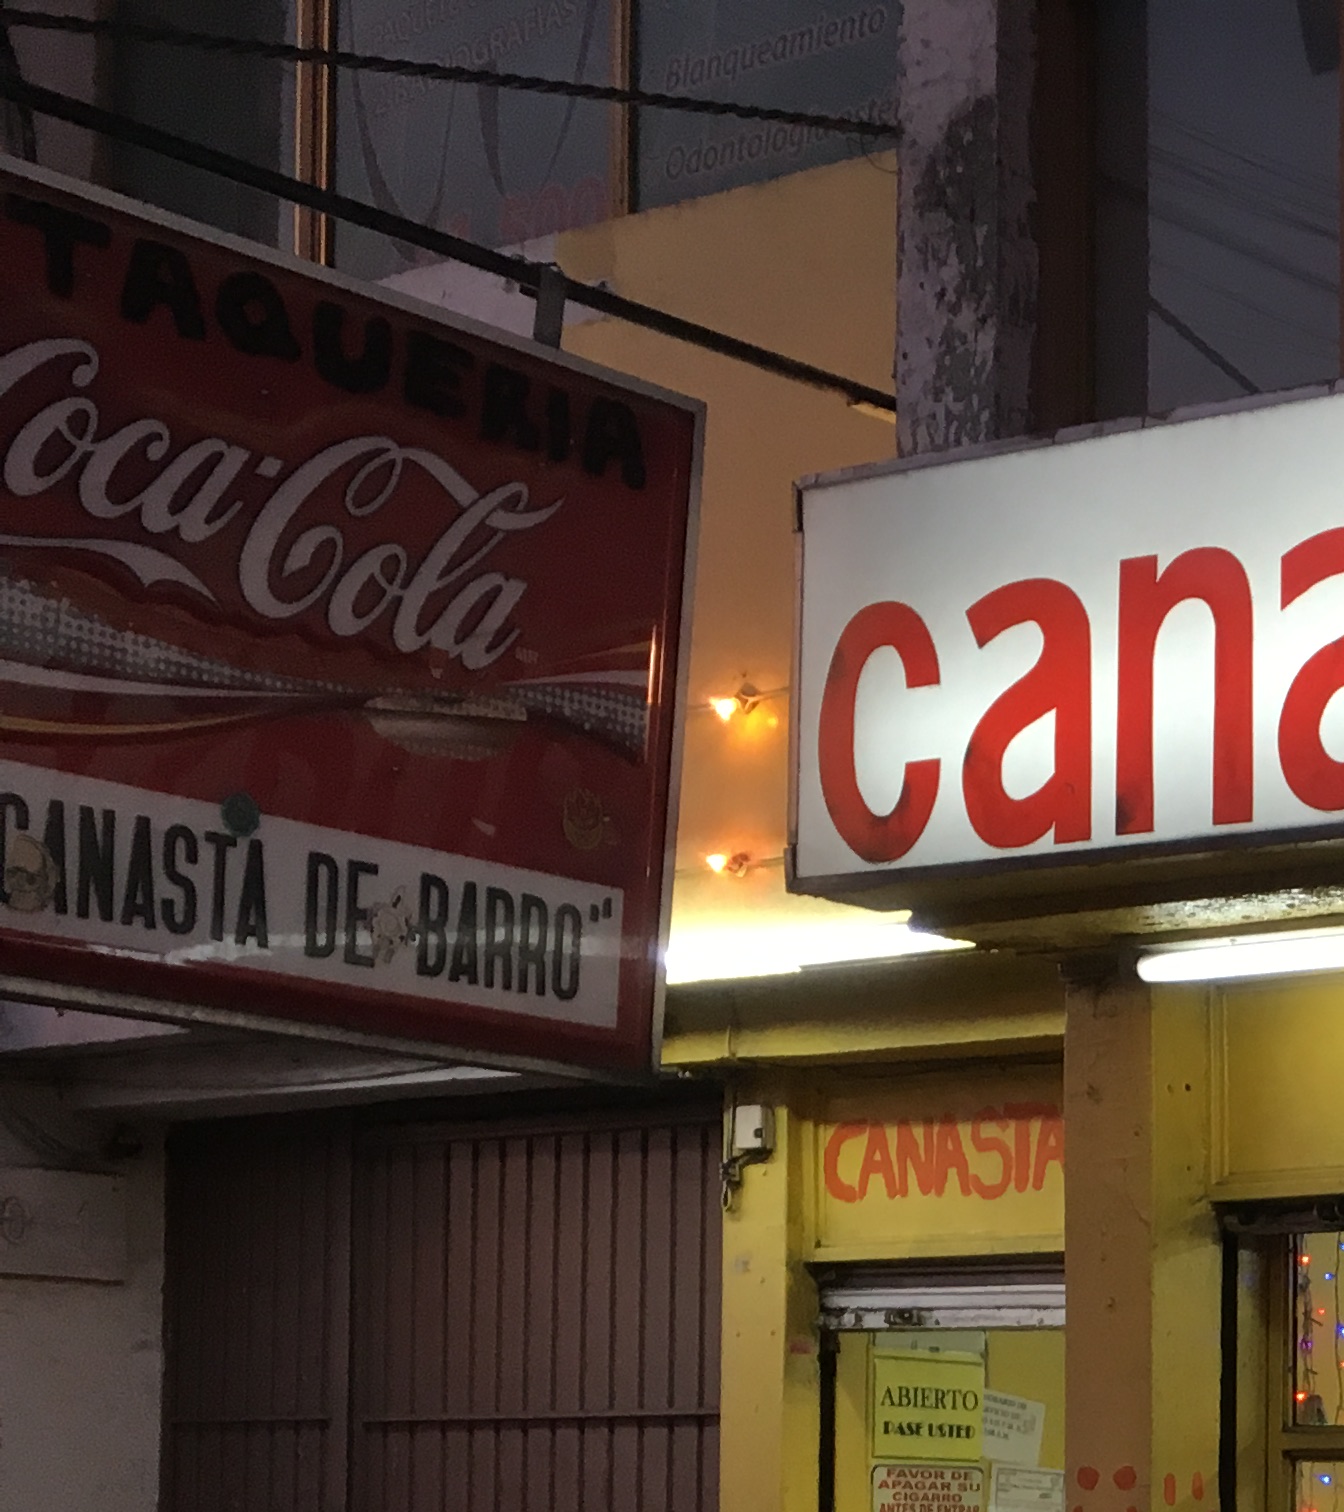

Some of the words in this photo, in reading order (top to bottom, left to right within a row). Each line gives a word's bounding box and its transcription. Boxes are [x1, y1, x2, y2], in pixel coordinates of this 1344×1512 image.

[394, 1, 578, 104] RAOGRAFIAS
[665, 8, 888, 92] Blanqueamiento
[5, 198, 646, 490] TAQUERIA
[304, 850, 379, 967] DE
[824, 1101, 1065, 1203] CANASTA
[880, 1386, 978, 1411] ABIERTO
[883, 1420, 923, 1437] PASE
[927, 1422, 976, 1440] USTED
[877, 1479, 952, 1493] APAGAR
[956, 1481, 981, 1493] SU
[886, 1468, 946, 1481] FAVOR
[950, 1470, 974, 1482] DE
[892, 1491, 964, 1504] CIGARRO
